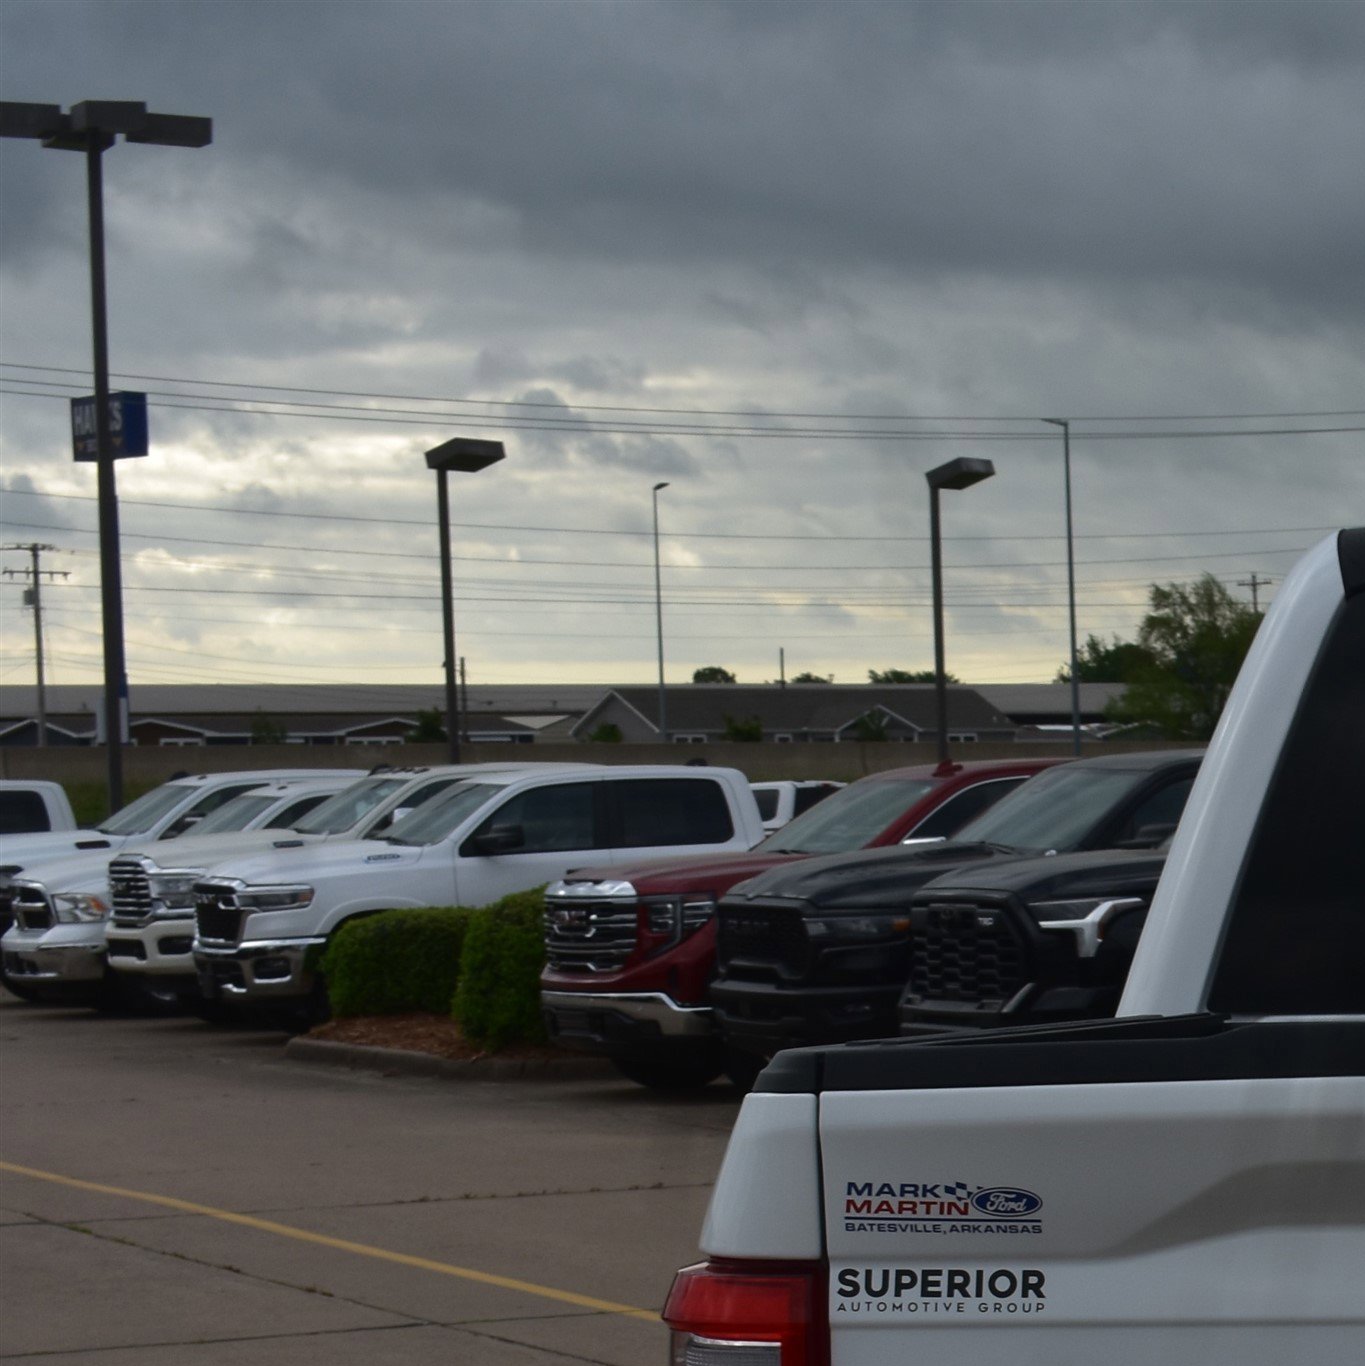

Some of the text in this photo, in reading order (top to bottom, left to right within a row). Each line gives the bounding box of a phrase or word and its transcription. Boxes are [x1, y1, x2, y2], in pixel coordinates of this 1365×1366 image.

[846, 1181, 941, 1199] MARK
[845, 1199, 970, 1216] MARTIN
[986, 1192, 1027, 1213] Ford
[845, 1222, 1043, 1235] BATESVILLE, ARKANSAS
[837, 1268, 1047, 1299] SUPERIOR
[837, 1301, 1045, 1313] AUTOMOTIVE GROUP
